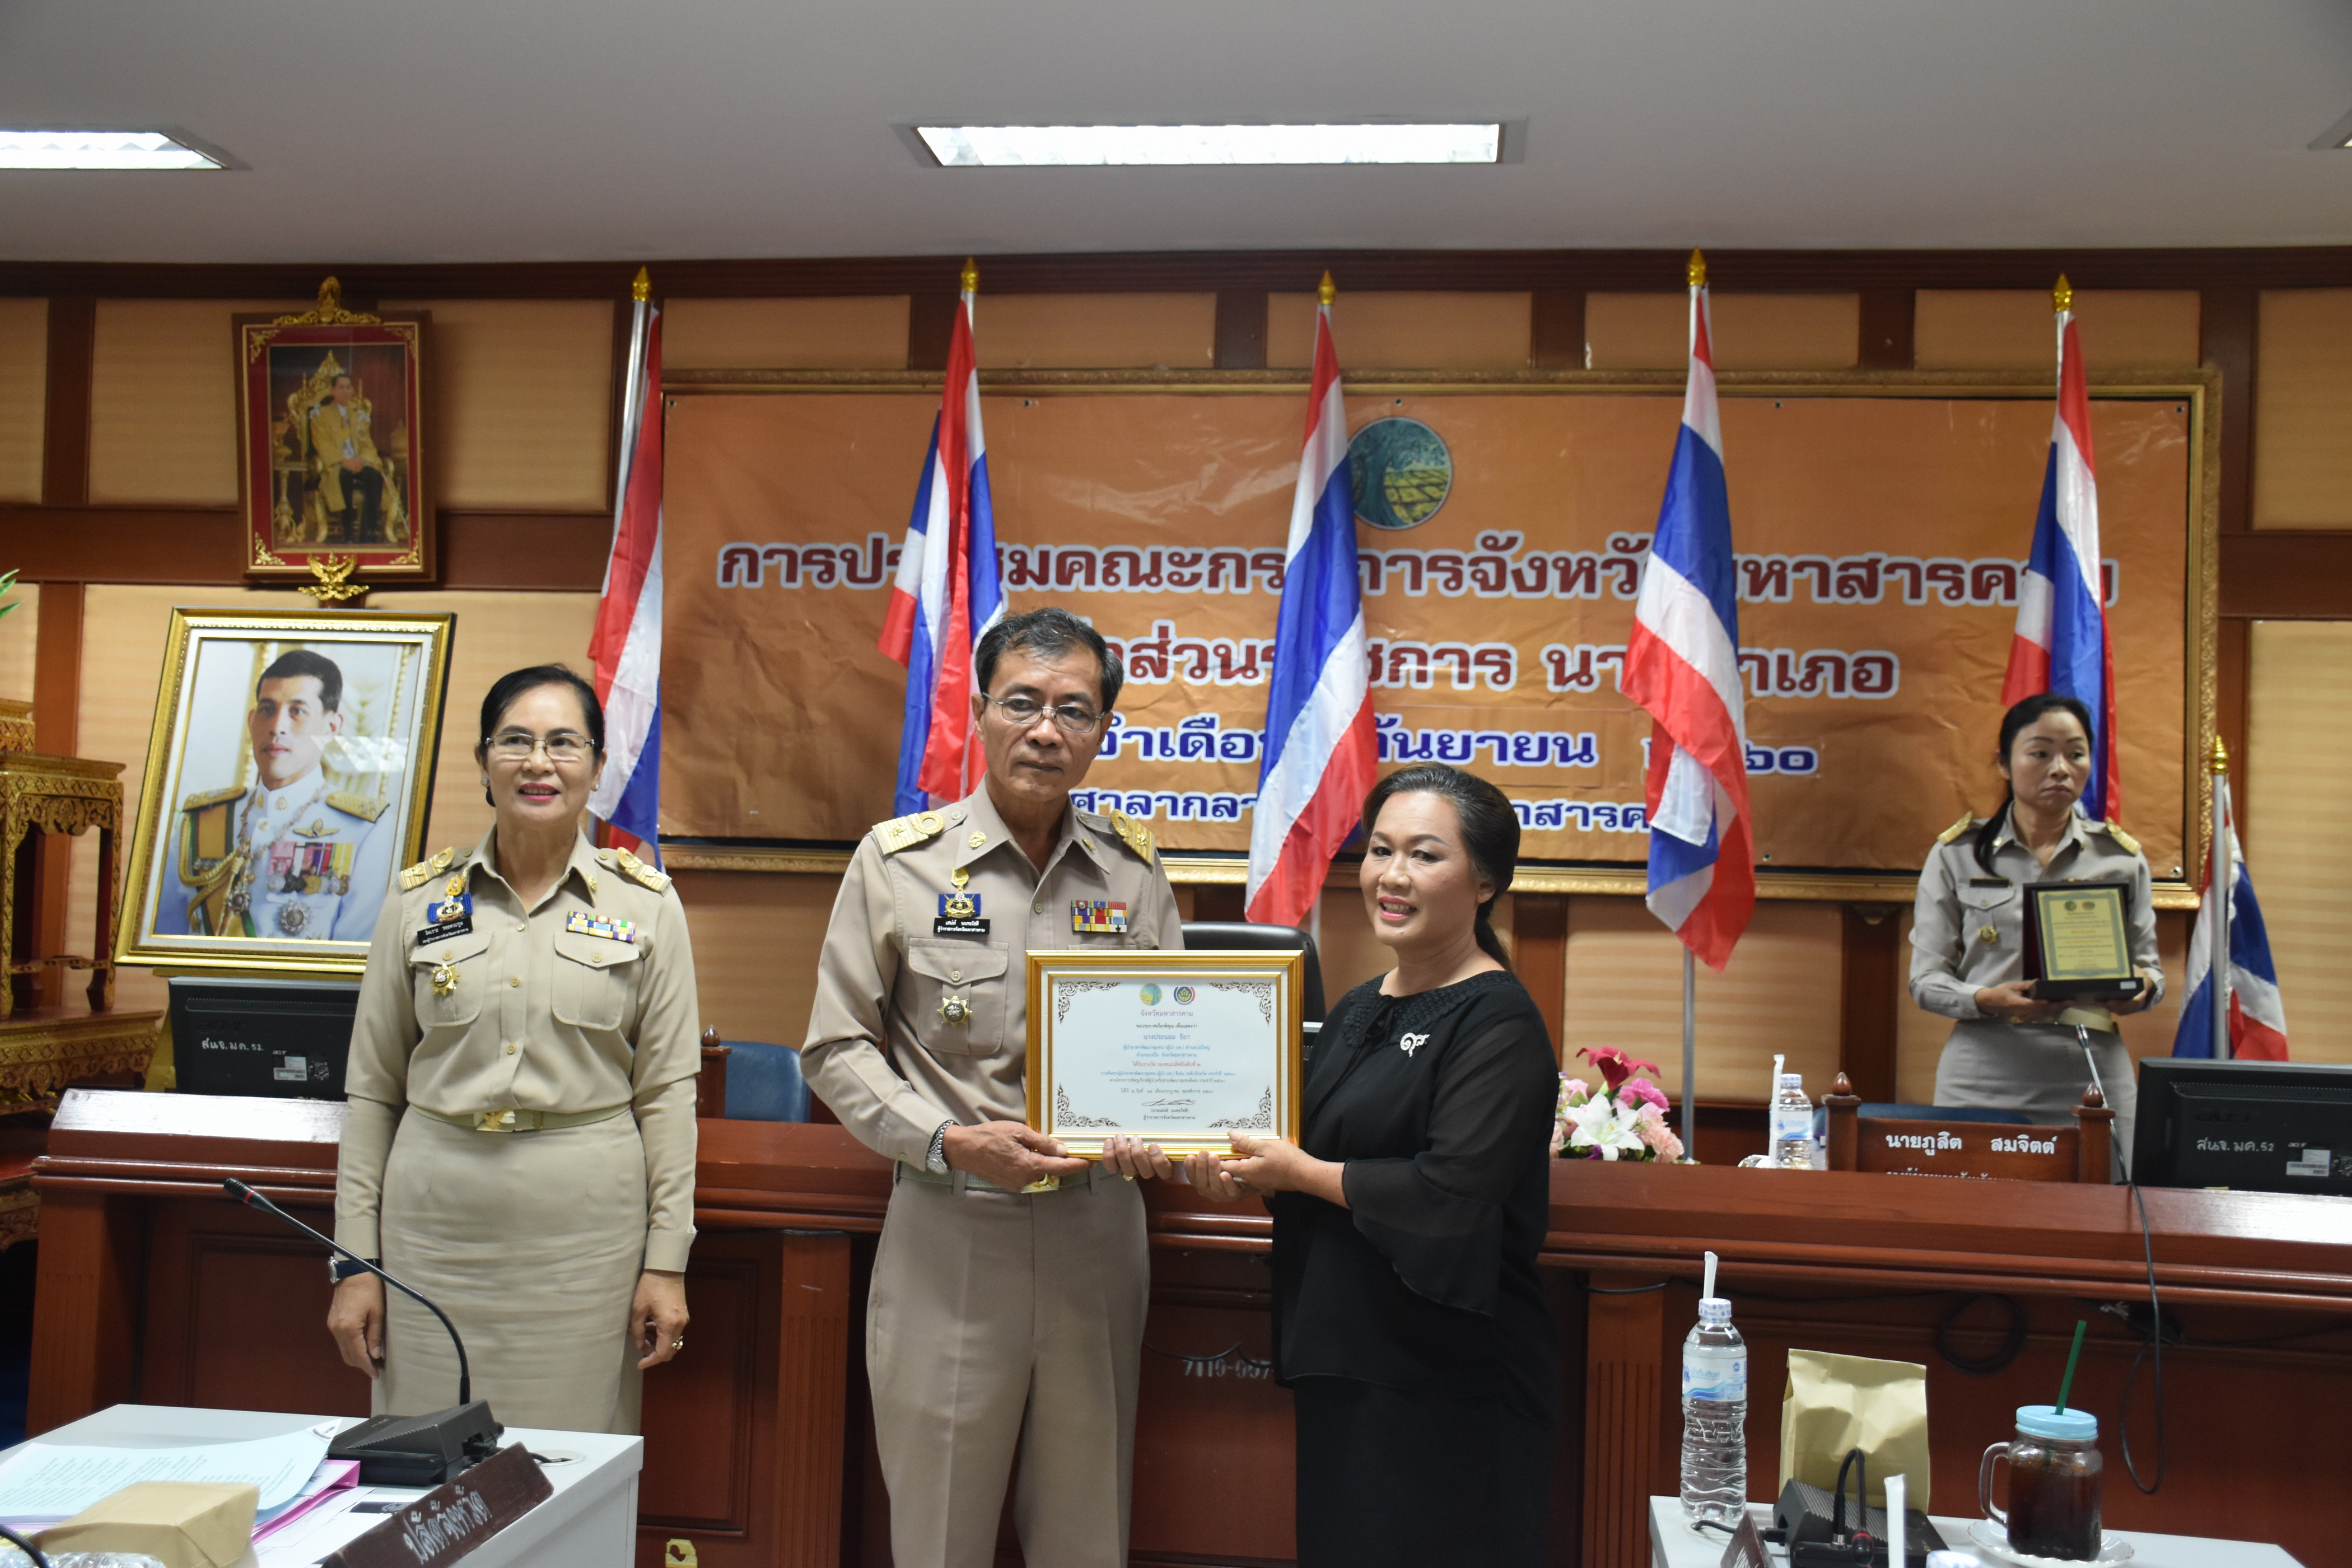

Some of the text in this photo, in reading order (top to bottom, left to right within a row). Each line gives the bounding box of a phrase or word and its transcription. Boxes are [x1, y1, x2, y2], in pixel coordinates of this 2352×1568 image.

[1885, 1131, 2058, 1156] นายภูสิต สมจิตต์
